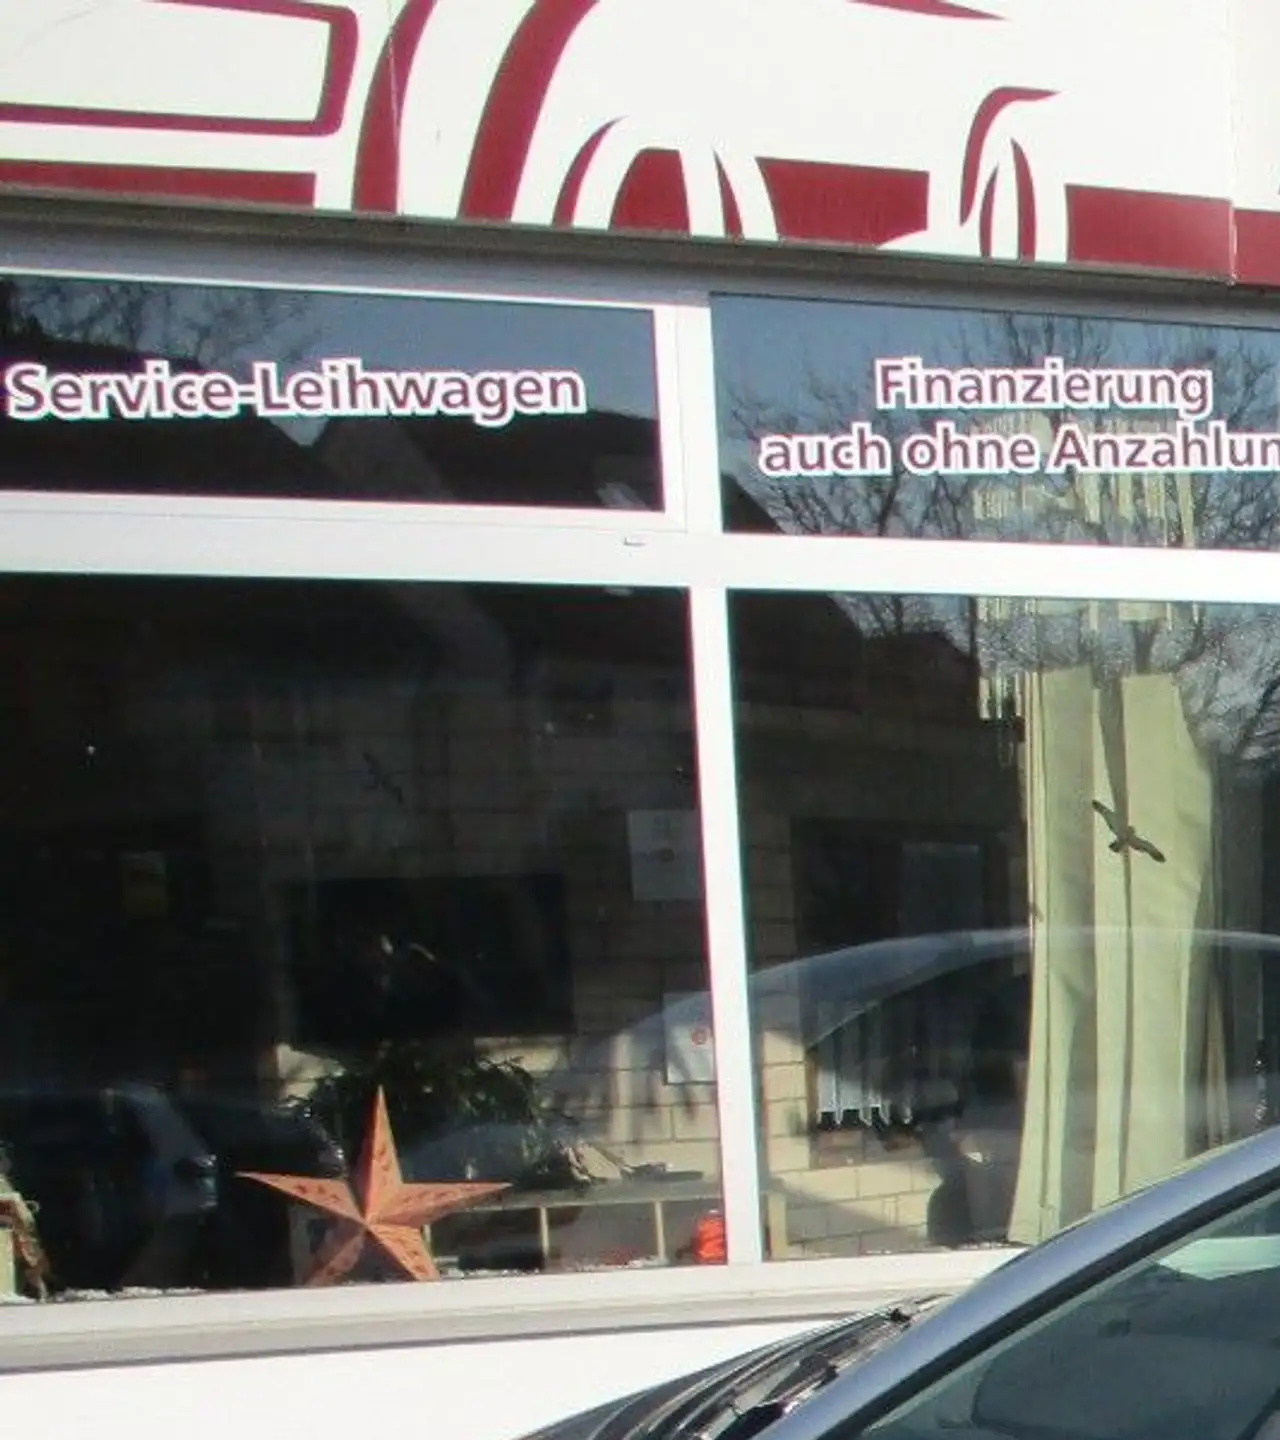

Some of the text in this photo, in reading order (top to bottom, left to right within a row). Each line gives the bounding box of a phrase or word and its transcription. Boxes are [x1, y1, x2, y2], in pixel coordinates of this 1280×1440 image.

[4, 360, 590, 426] Service-Leihwagen
[873, 356, 1215, 417] Finanzierung
[757, 421, 892, 477] auch
[898, 421, 1039, 477] ohne
